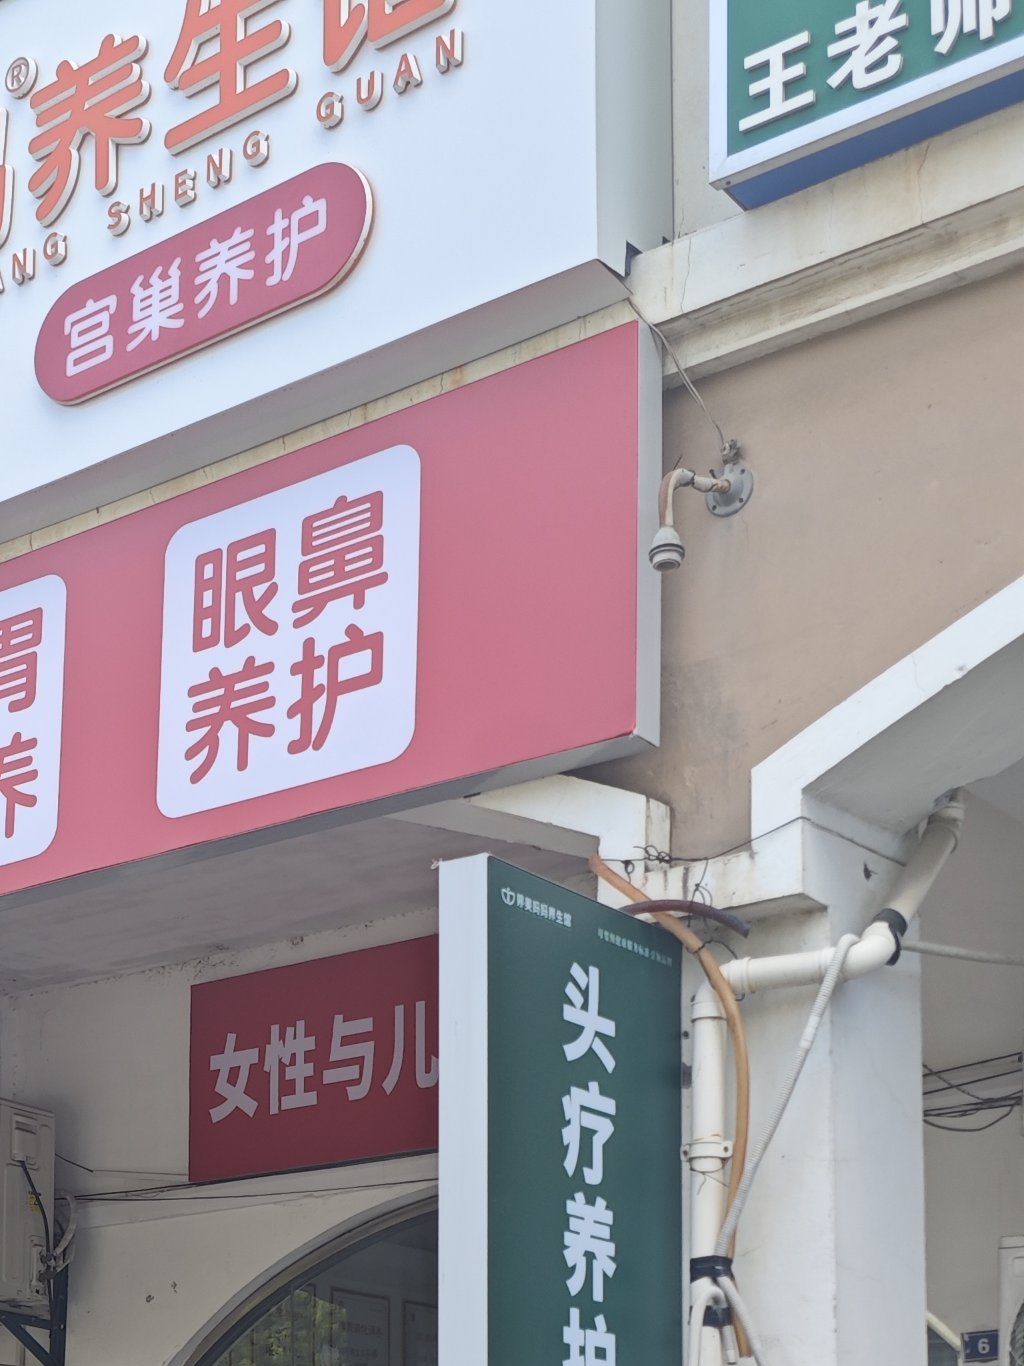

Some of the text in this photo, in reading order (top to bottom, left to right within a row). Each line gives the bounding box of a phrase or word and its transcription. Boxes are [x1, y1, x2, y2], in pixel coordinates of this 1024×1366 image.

[106, 129, 271, 238] SHENG
[316, 28, 465, 129] GUAN
[63, 192, 329, 379] 宫巢养护
[191, 489, 389, 654] 眼鼻
[183, 624, 384, 786] 养护
[207, 1000, 439, 1126] 女性与儿
